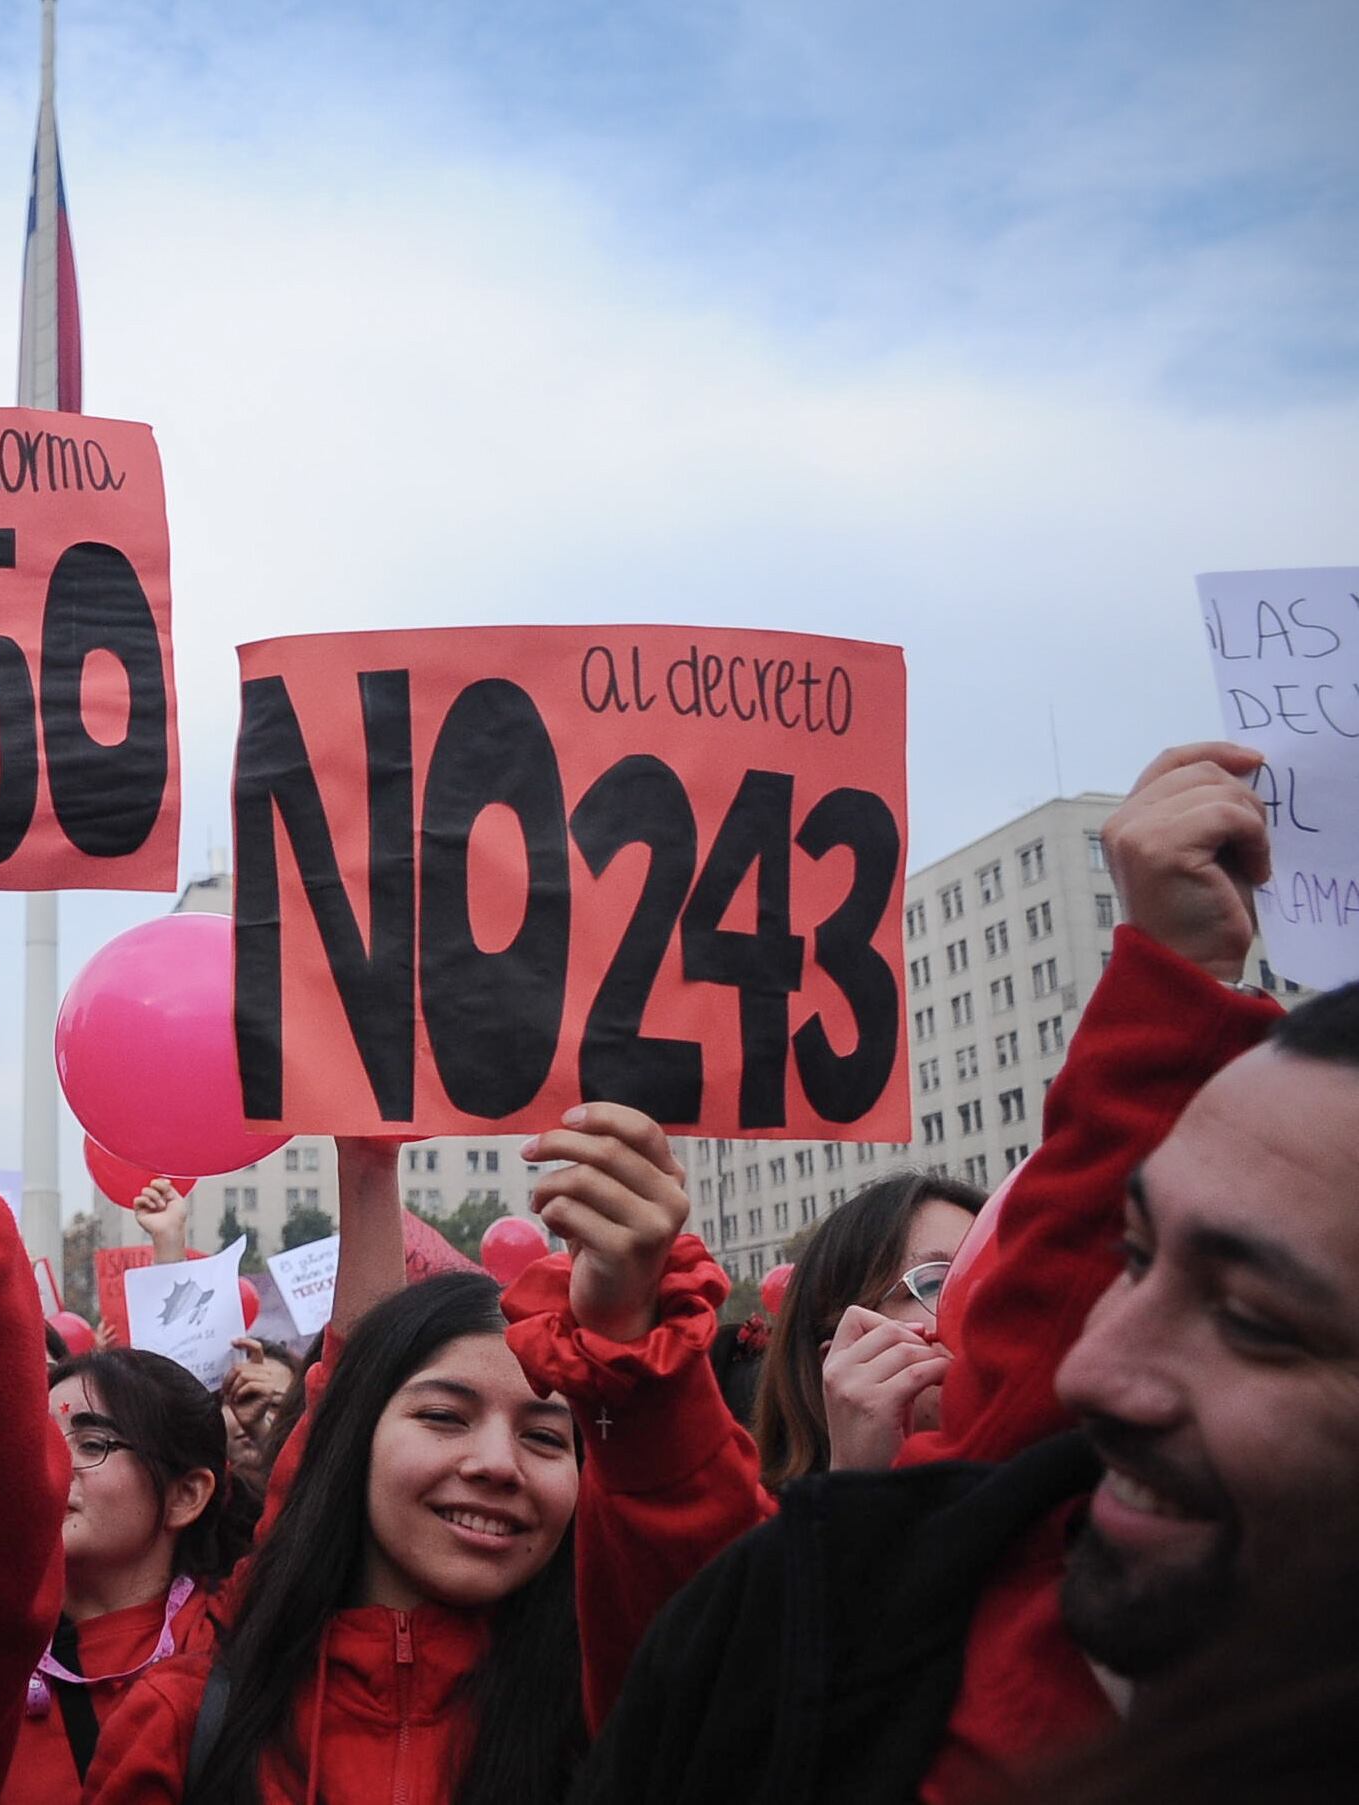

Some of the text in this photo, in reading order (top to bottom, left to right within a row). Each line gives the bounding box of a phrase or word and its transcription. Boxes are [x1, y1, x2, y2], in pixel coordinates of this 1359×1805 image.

[666, 645, 853, 736] decreto
[1227, 683, 1359, 738] DEC
[1252, 762, 1320, 833] AL
